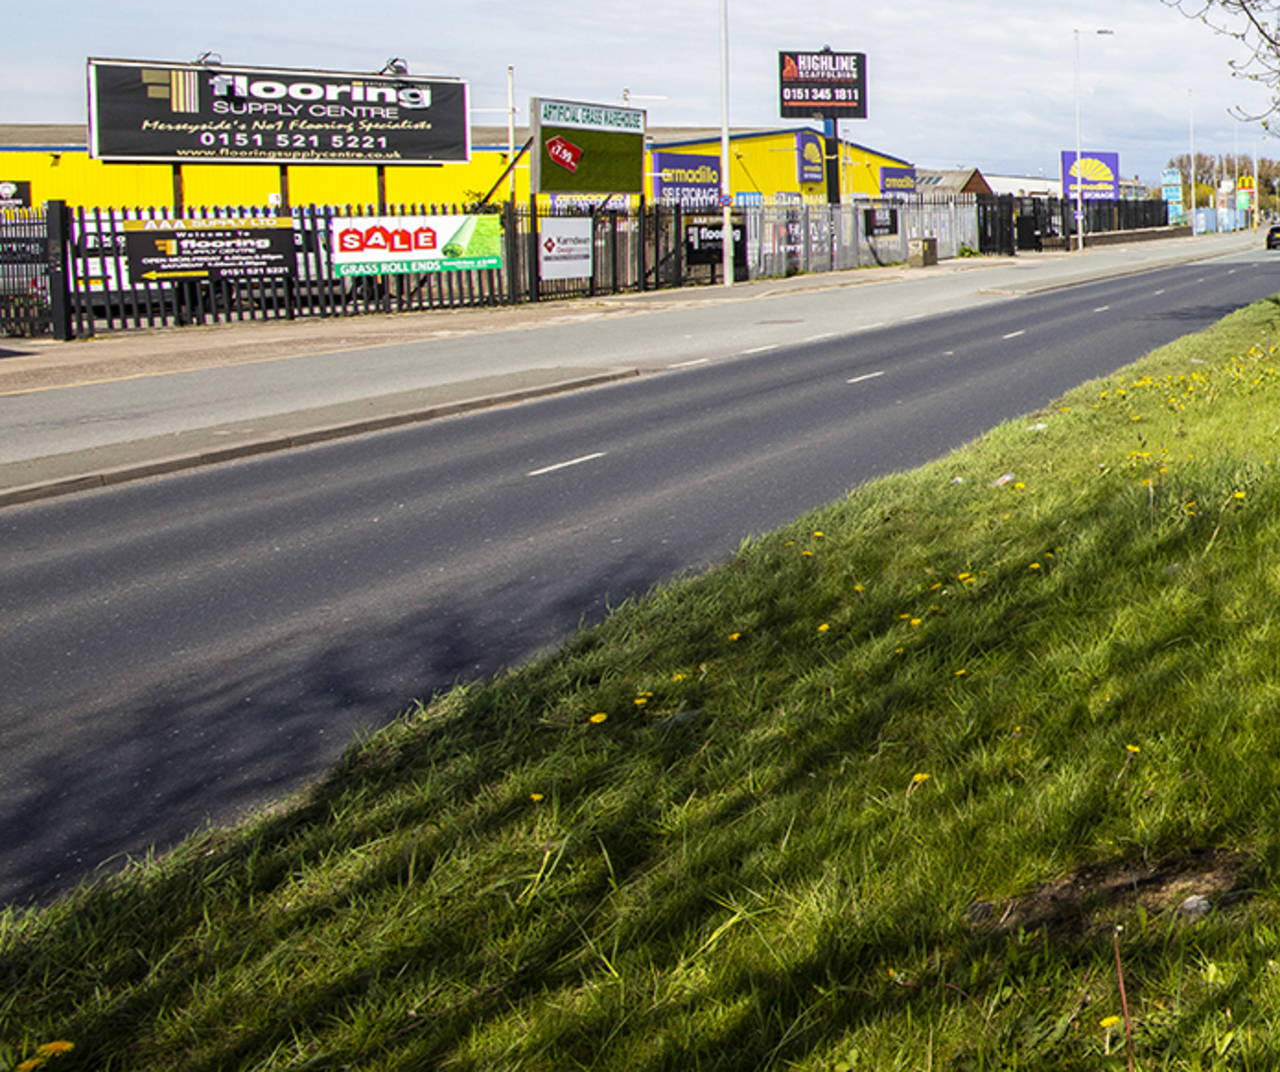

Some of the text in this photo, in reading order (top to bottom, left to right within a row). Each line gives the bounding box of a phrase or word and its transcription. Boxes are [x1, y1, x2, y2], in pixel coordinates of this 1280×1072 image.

[798, 55, 858, 71] HIGHLINE
[798, 71, 858, 79] SCAFFOLDING
[209, 74, 432, 109] flooring
[783, 88, 859, 100] 0151 345 1811
[212, 100, 399, 119] SUPPLY CENTRE
[542, 103, 579, 123] ARTIFICIAL
[142, 119, 433, 135] Merseyside's No1 Flooring Specialists
[200, 132, 388, 149] 0151 521 5221
[661, 165, 719, 184] armadillo
[144, 217, 278, 230] AAA SUPPLY LTD
[180, 238, 271, 250] flooring
[343, 231, 434, 249] SALE
[220, 268, 244, 276] 0151
[339, 264, 378, 275] GRASS
[380, 262, 409, 274] ROLL
[411, 260, 440, 272] ENDS
